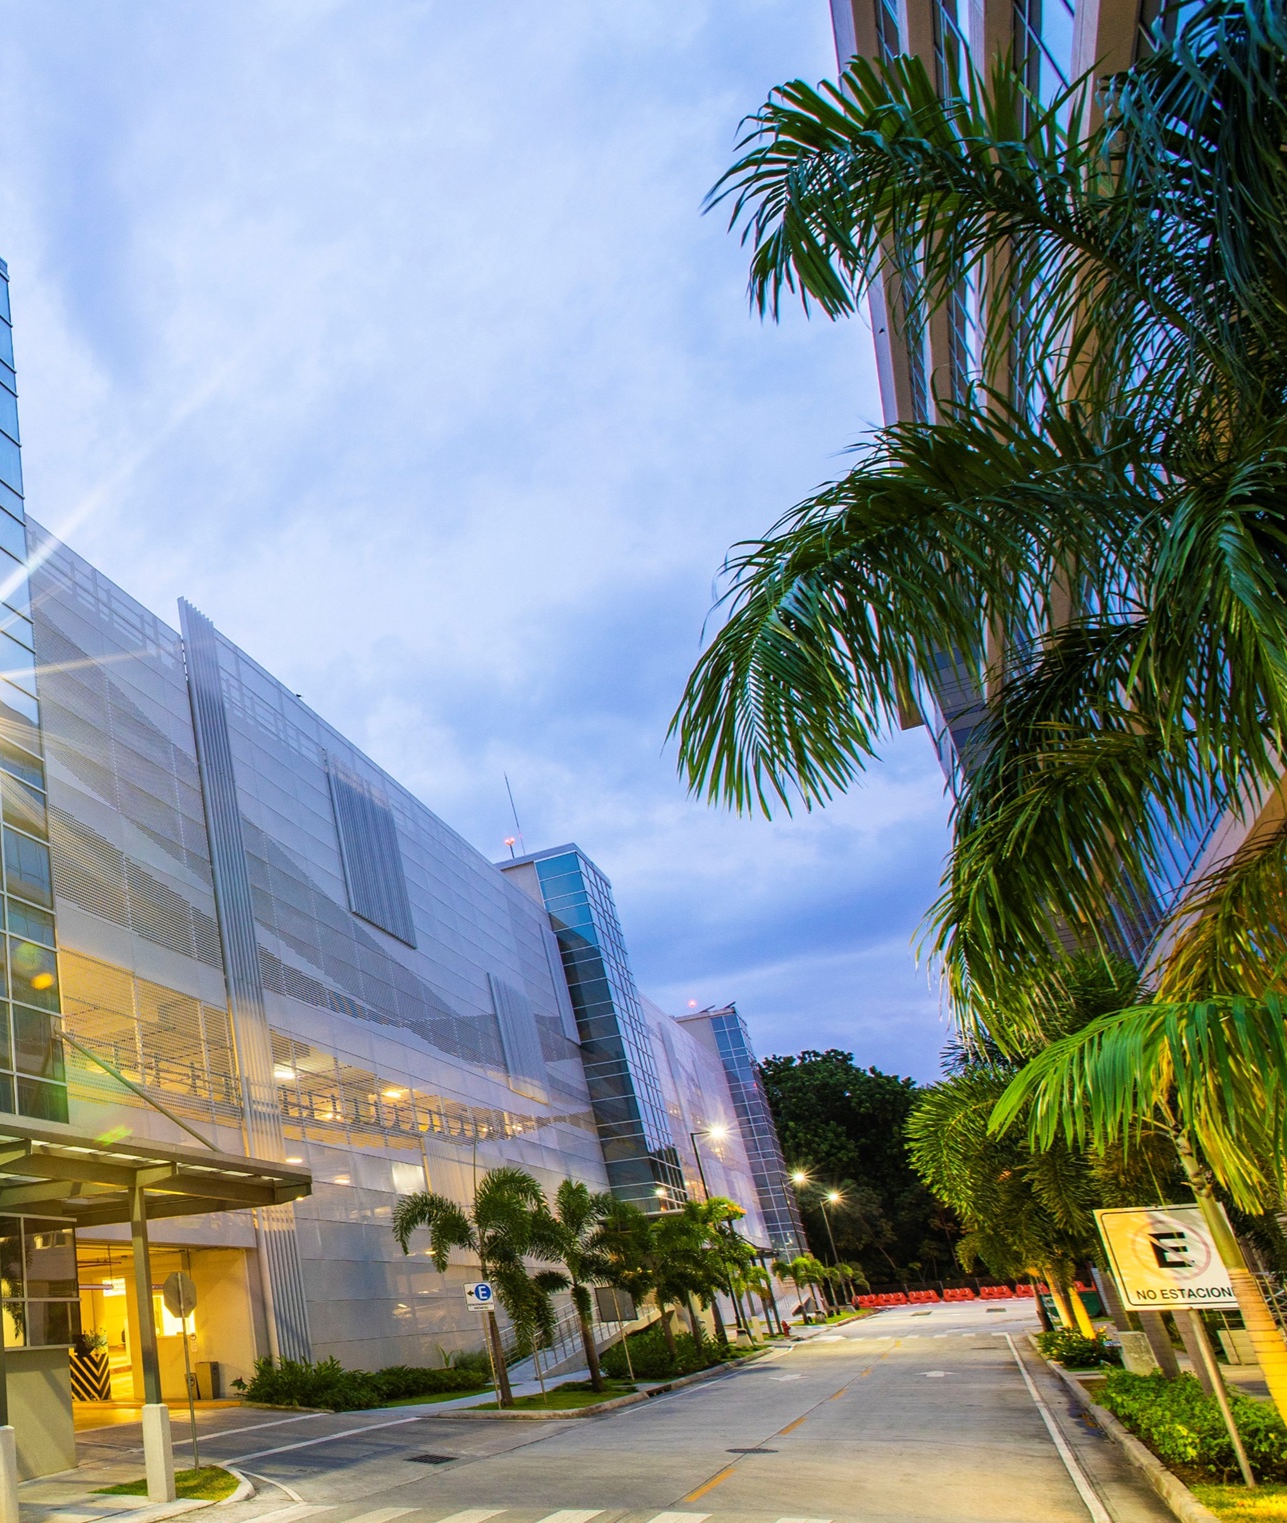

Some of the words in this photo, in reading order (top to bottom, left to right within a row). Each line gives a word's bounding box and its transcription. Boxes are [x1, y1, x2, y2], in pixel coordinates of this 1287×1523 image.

[1147, 1232, 1195, 1268] E
[478, 1286, 488, 1299] E
[1136, 1289, 1157, 1300] NO
[1160, 1287, 1234, 1299] ESTACION
